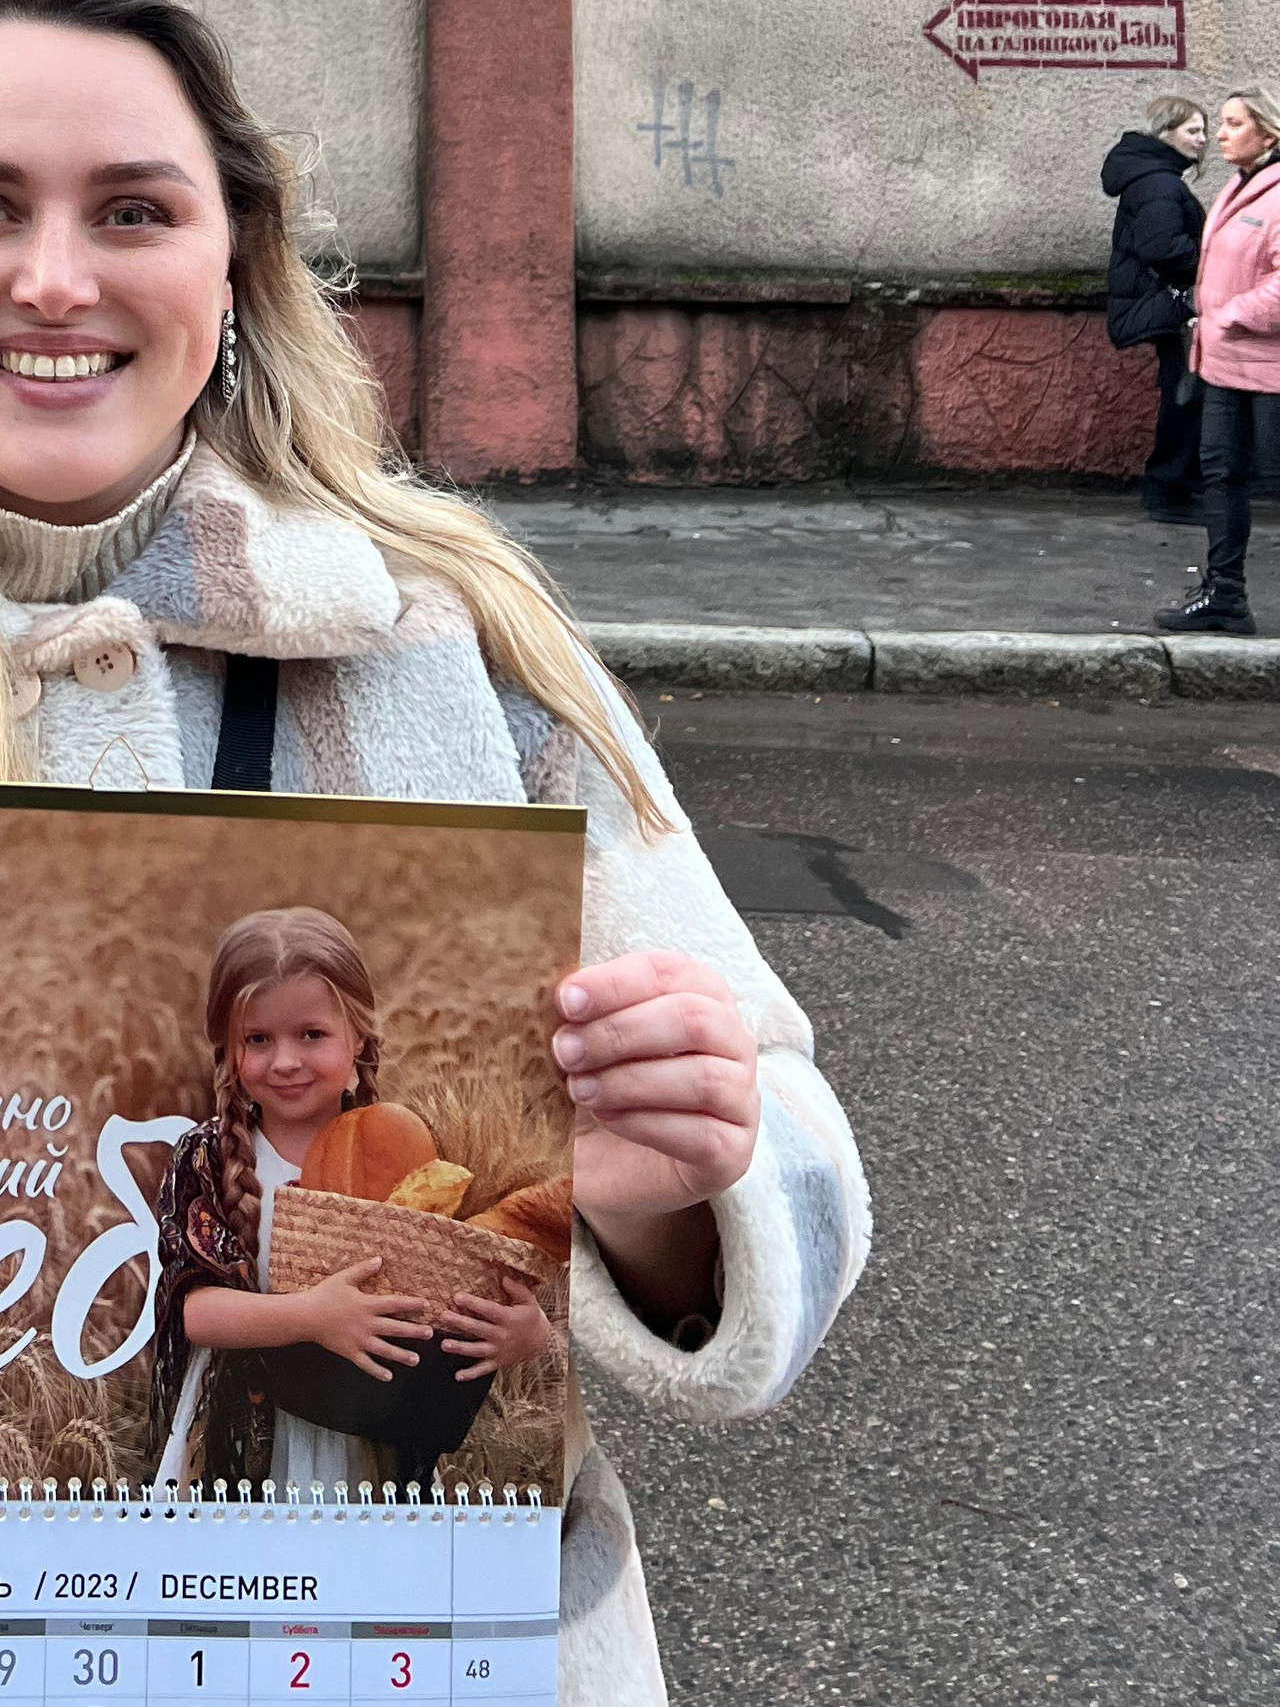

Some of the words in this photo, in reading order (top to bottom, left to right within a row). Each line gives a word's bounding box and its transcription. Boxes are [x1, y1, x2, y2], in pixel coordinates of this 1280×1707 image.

[160, 1573, 319, 1601] DECEMBER
[73, 1648, 119, 1686] 30
[190, 1650, 204, 1687] 1
[290, 1652, 311, 1689] 2
[390, 1652, 412, 1689] 3
[465, 1659, 491, 1680] 48
